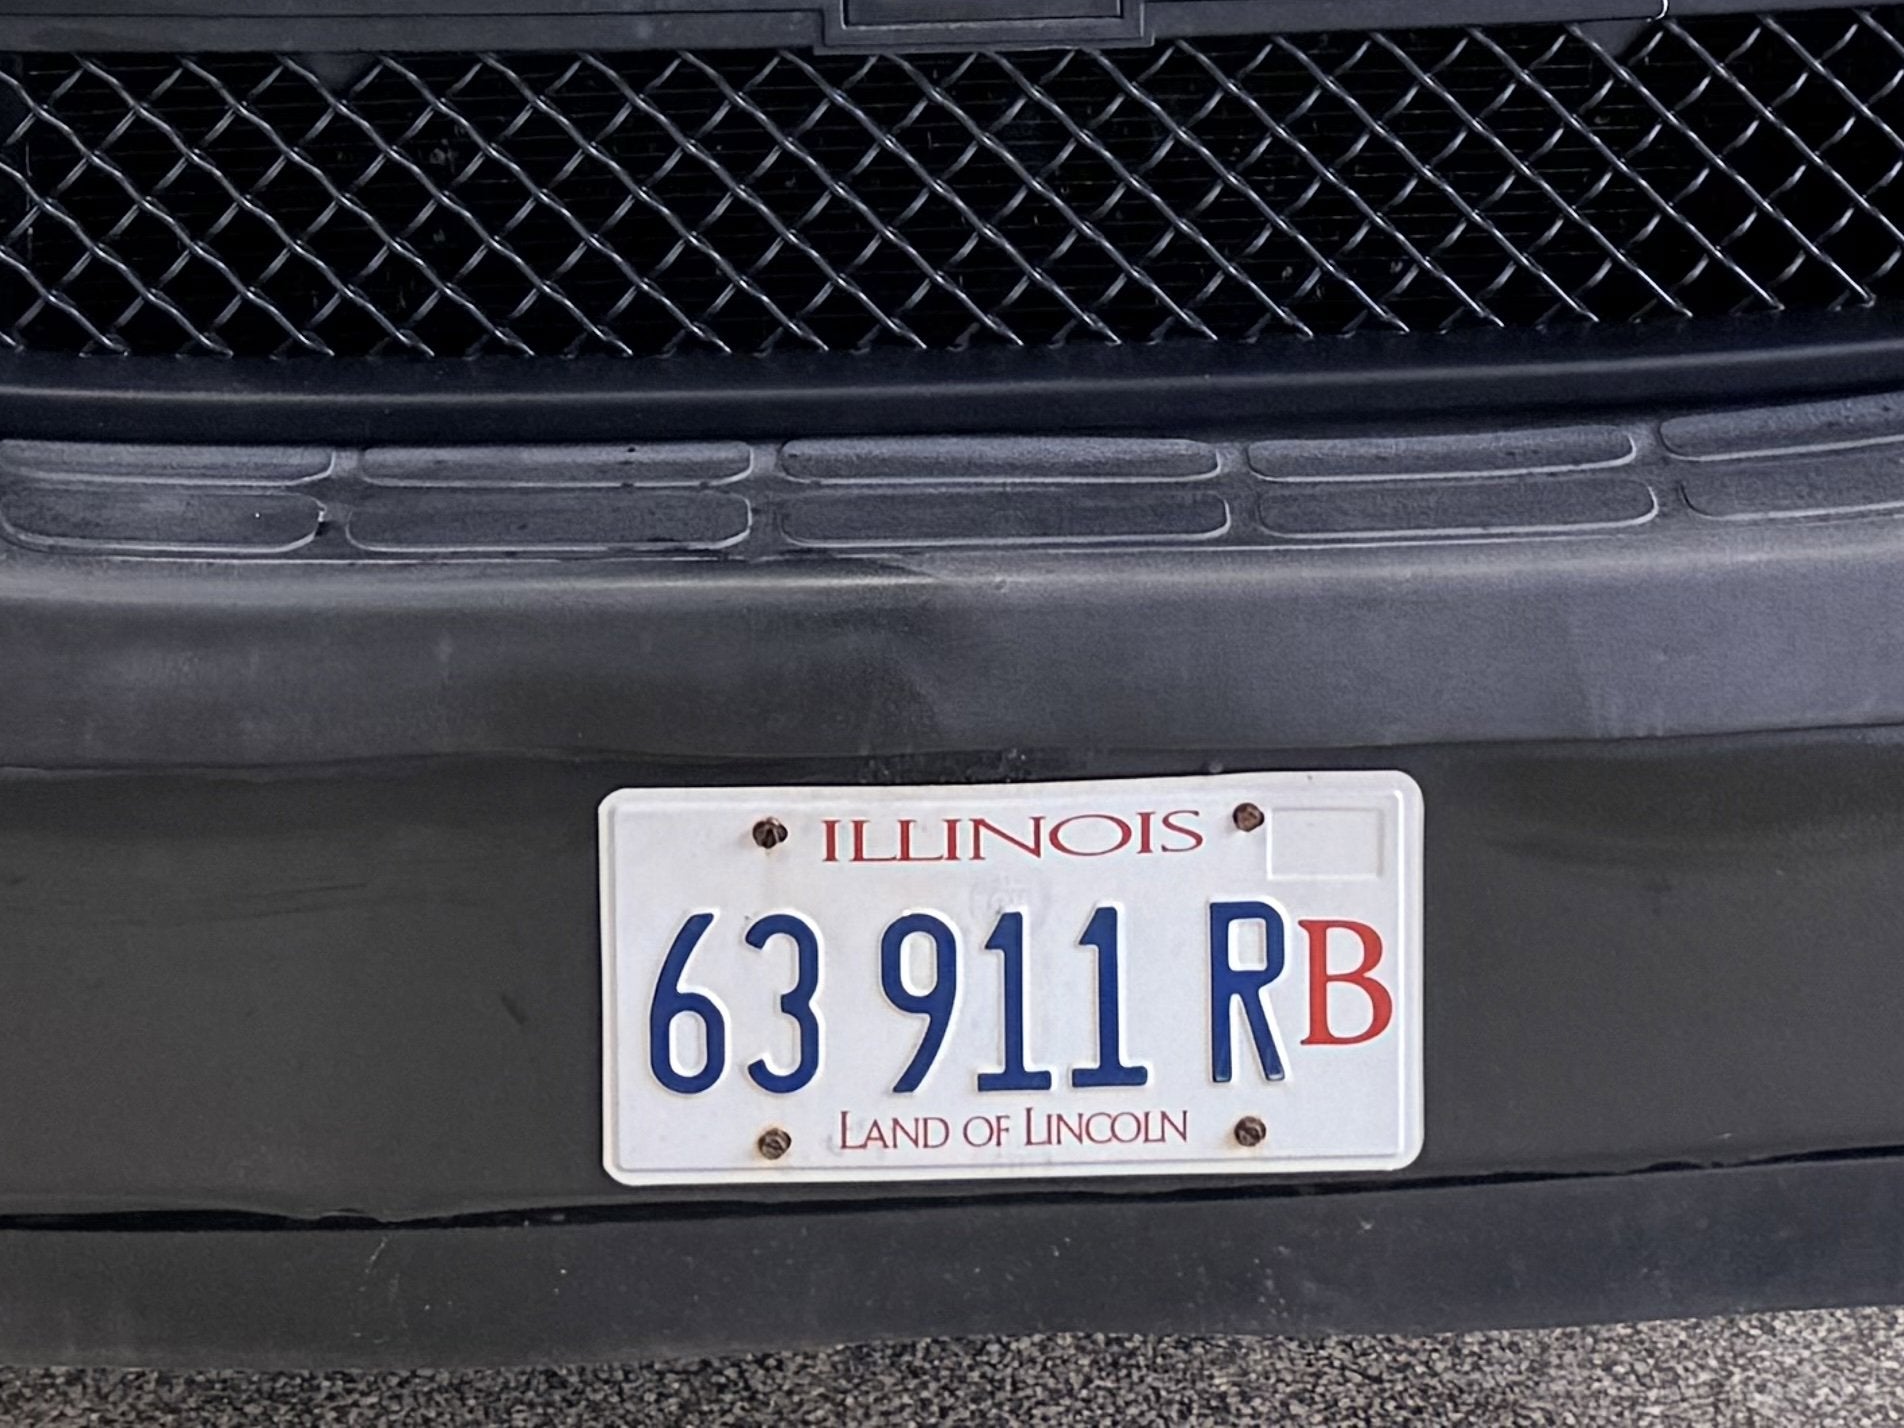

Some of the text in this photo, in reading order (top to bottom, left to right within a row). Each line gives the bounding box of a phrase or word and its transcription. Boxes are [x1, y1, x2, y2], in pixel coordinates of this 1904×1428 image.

[822, 808, 1205, 864] ILLINOIS
[649, 899, 1394, 1095] 63 911 R B
[839, 1108, 953, 1151] LAND
[1023, 1107, 1190, 1147] LINCOLN
